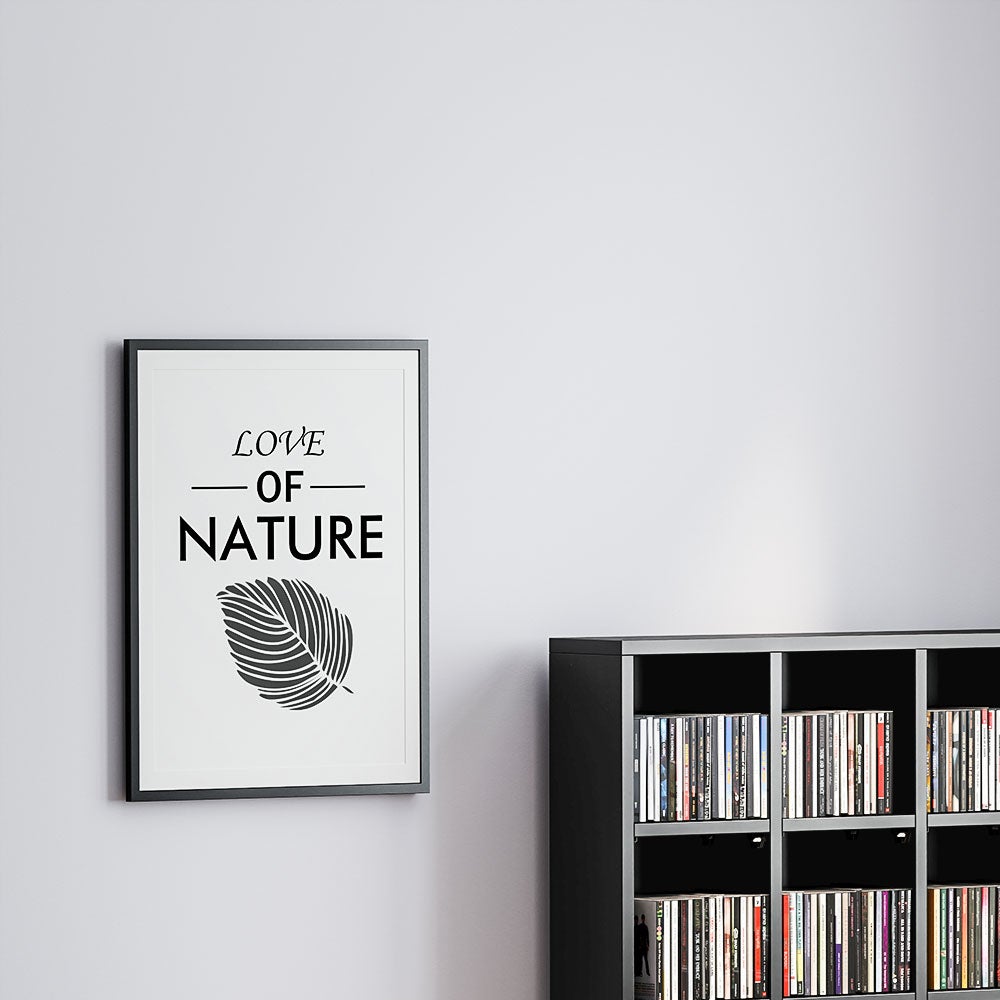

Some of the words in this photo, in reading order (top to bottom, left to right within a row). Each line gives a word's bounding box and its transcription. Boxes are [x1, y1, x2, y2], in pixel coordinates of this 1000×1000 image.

[232, 426, 325, 456] LOVE
[257, 471, 303, 503] OF
[180, 515, 382, 561] NATURE
